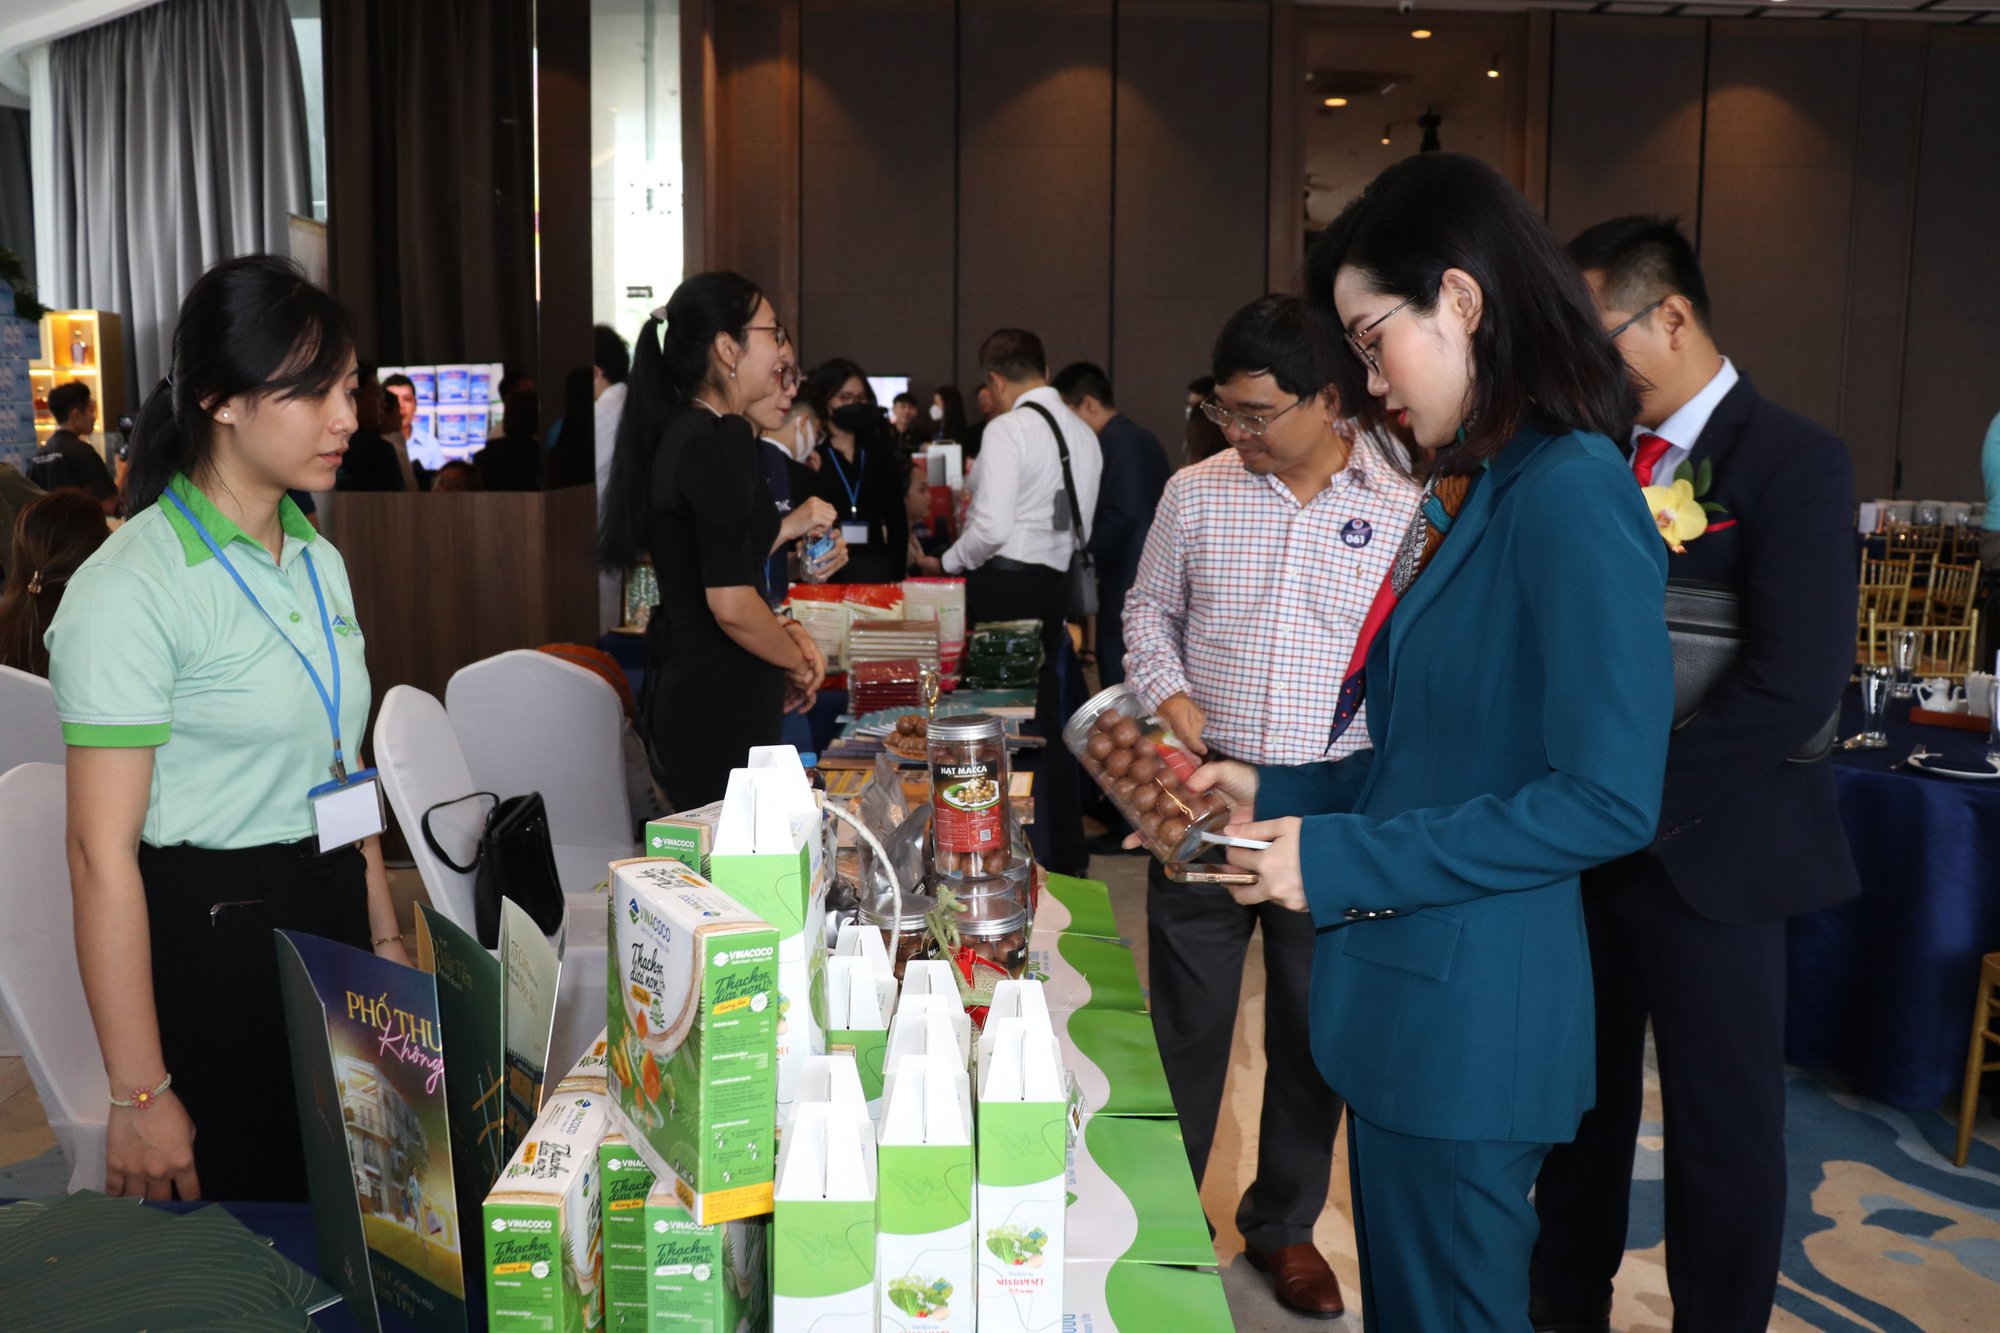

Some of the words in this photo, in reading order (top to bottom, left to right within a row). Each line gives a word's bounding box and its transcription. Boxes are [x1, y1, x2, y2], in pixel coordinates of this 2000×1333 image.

[1346, 534, 1365, 545] 061
[958, 764, 988, 775] MACCA
[663, 838, 694, 848] VINACOCO
[640, 905, 671, 943] VINACOCO
[729, 947, 773, 959] VINACOCO
[345, 992, 392, 1032] PHỐ
[378, 1019, 445, 1095] Không
[622, 1159, 646, 1168] VINAC
[508, 1219, 552, 1229] VINACOCO
[669, 1220, 714, 1231] VINACOO
